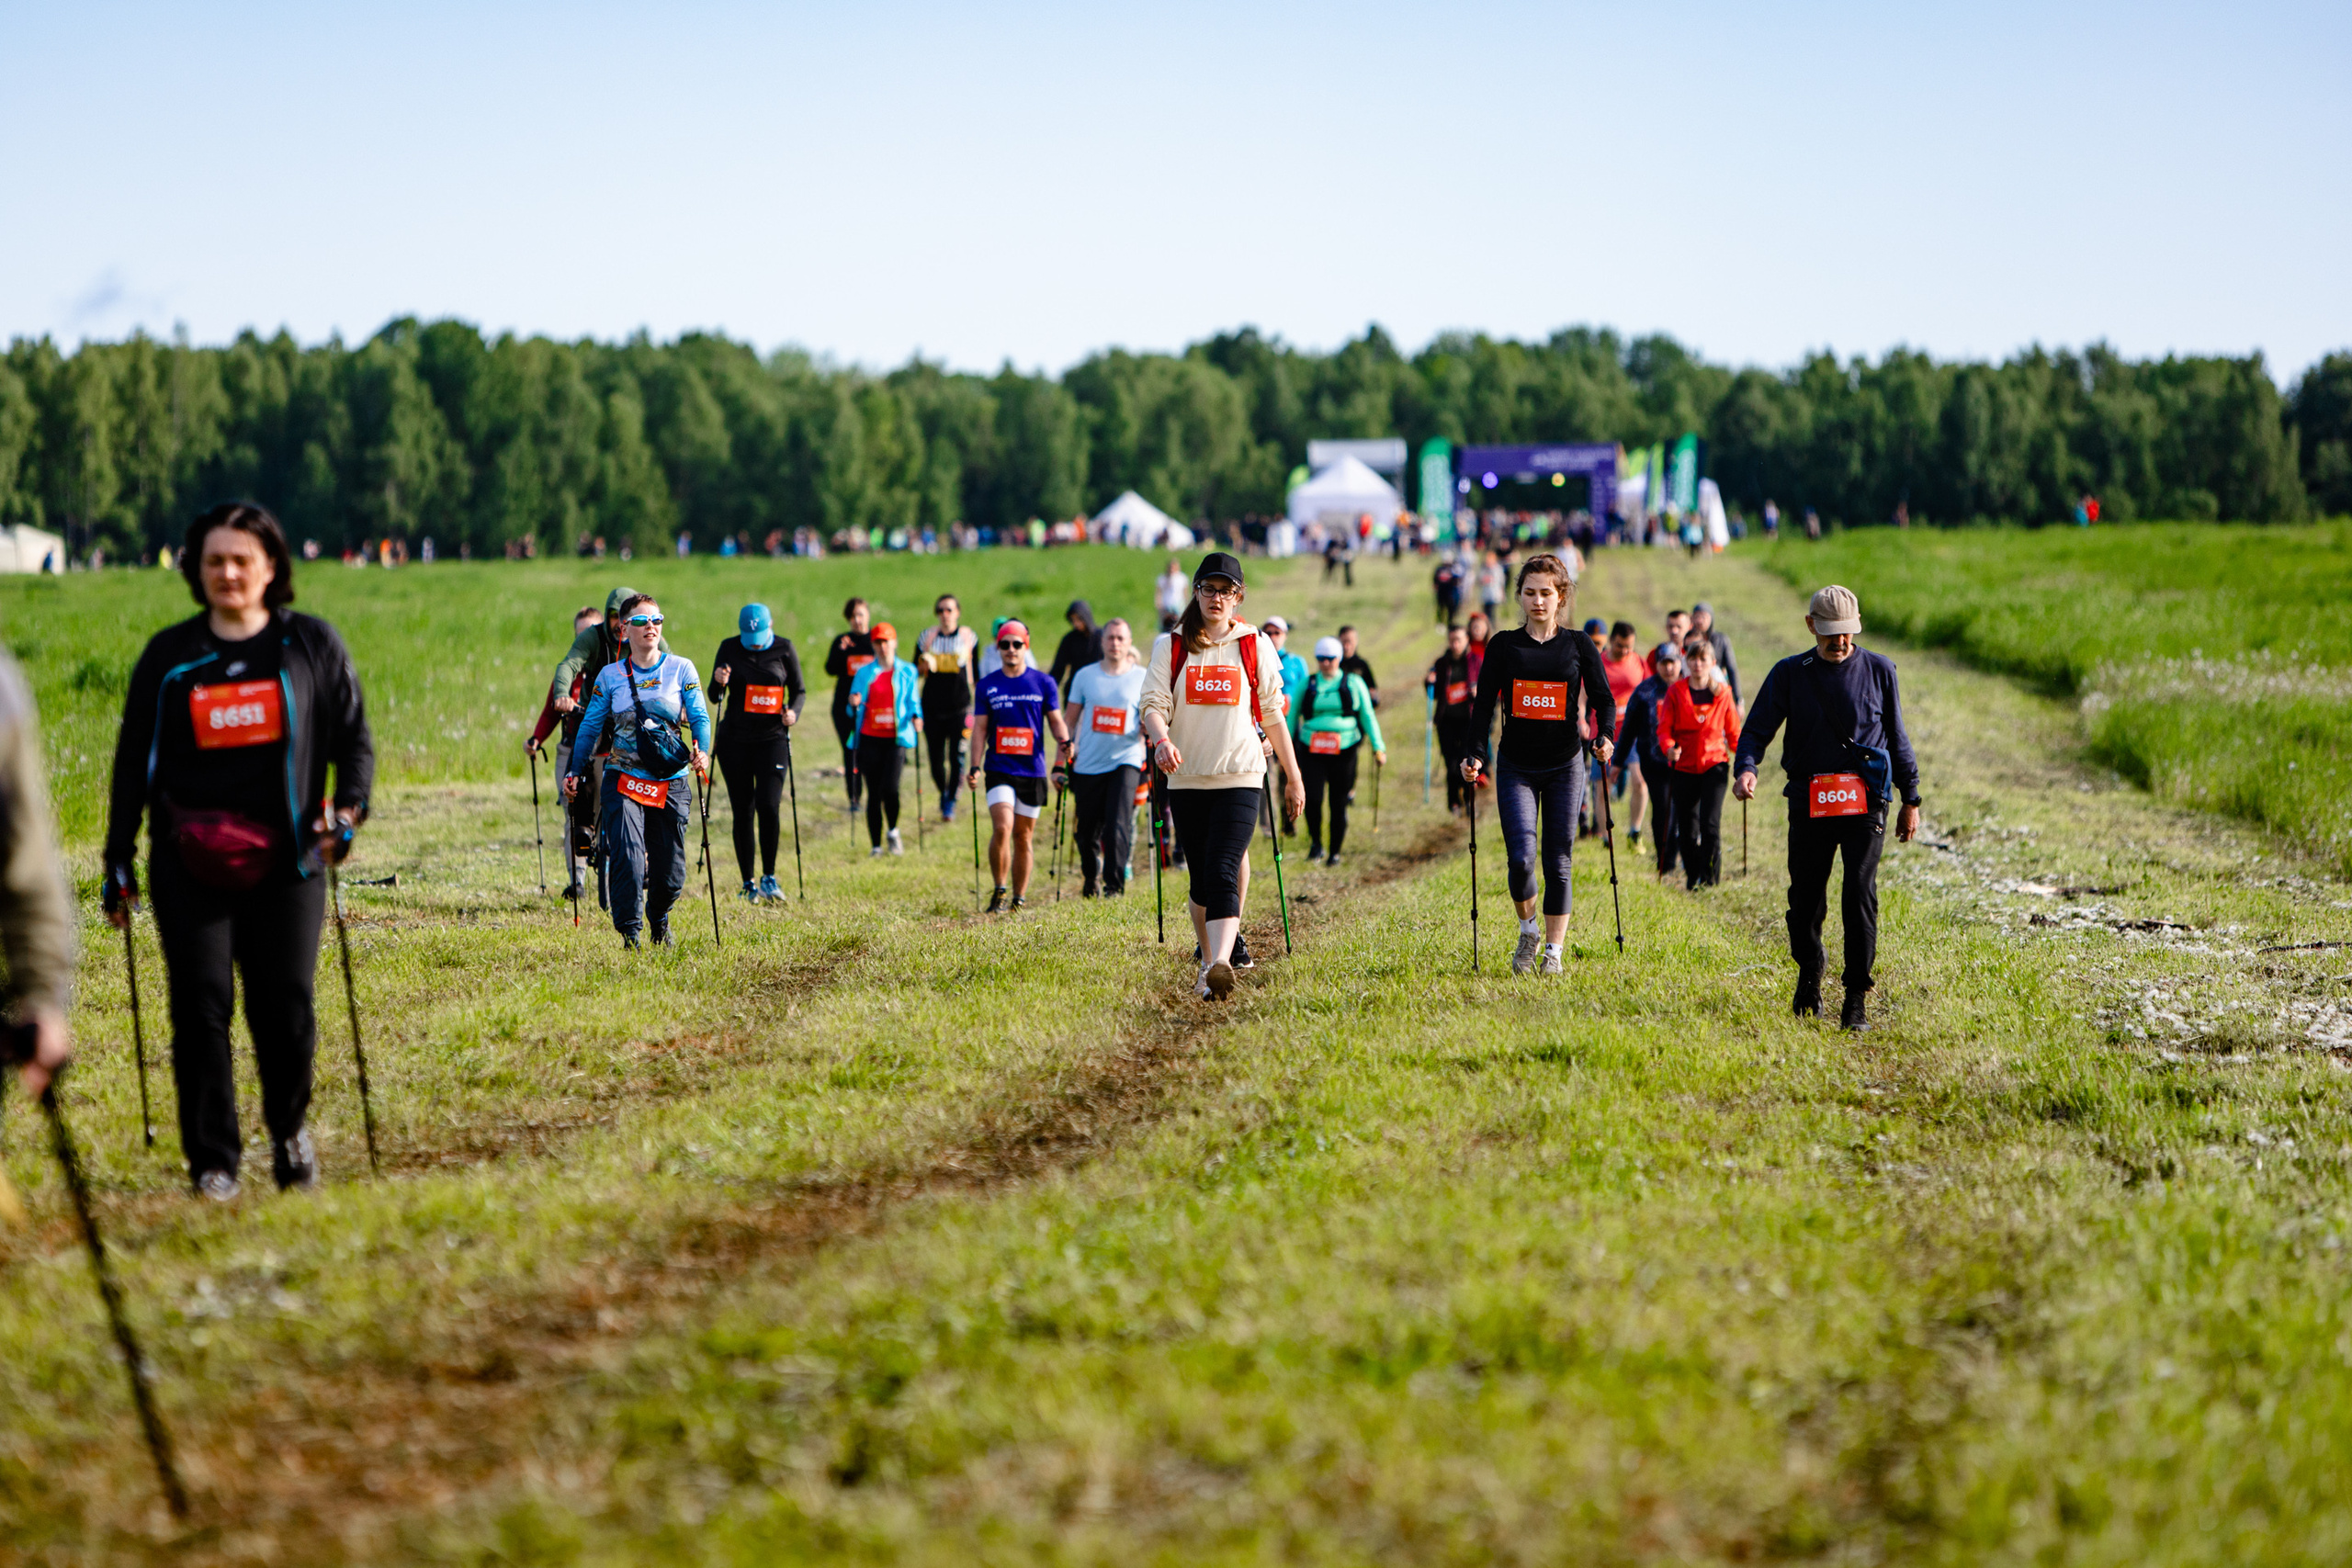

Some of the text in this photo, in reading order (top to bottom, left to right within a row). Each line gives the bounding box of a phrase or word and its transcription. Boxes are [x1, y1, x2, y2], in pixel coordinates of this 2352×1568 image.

[1195, 680, 1232, 692] 8626
[752, 695, 777, 706] 8624
[1522, 695, 1556, 707] 8681
[209, 702, 266, 730] 8651
[1001, 737, 1028, 748] 8630
[627, 780, 659, 798] 8652
[1817, 789, 1858, 804] 8604
